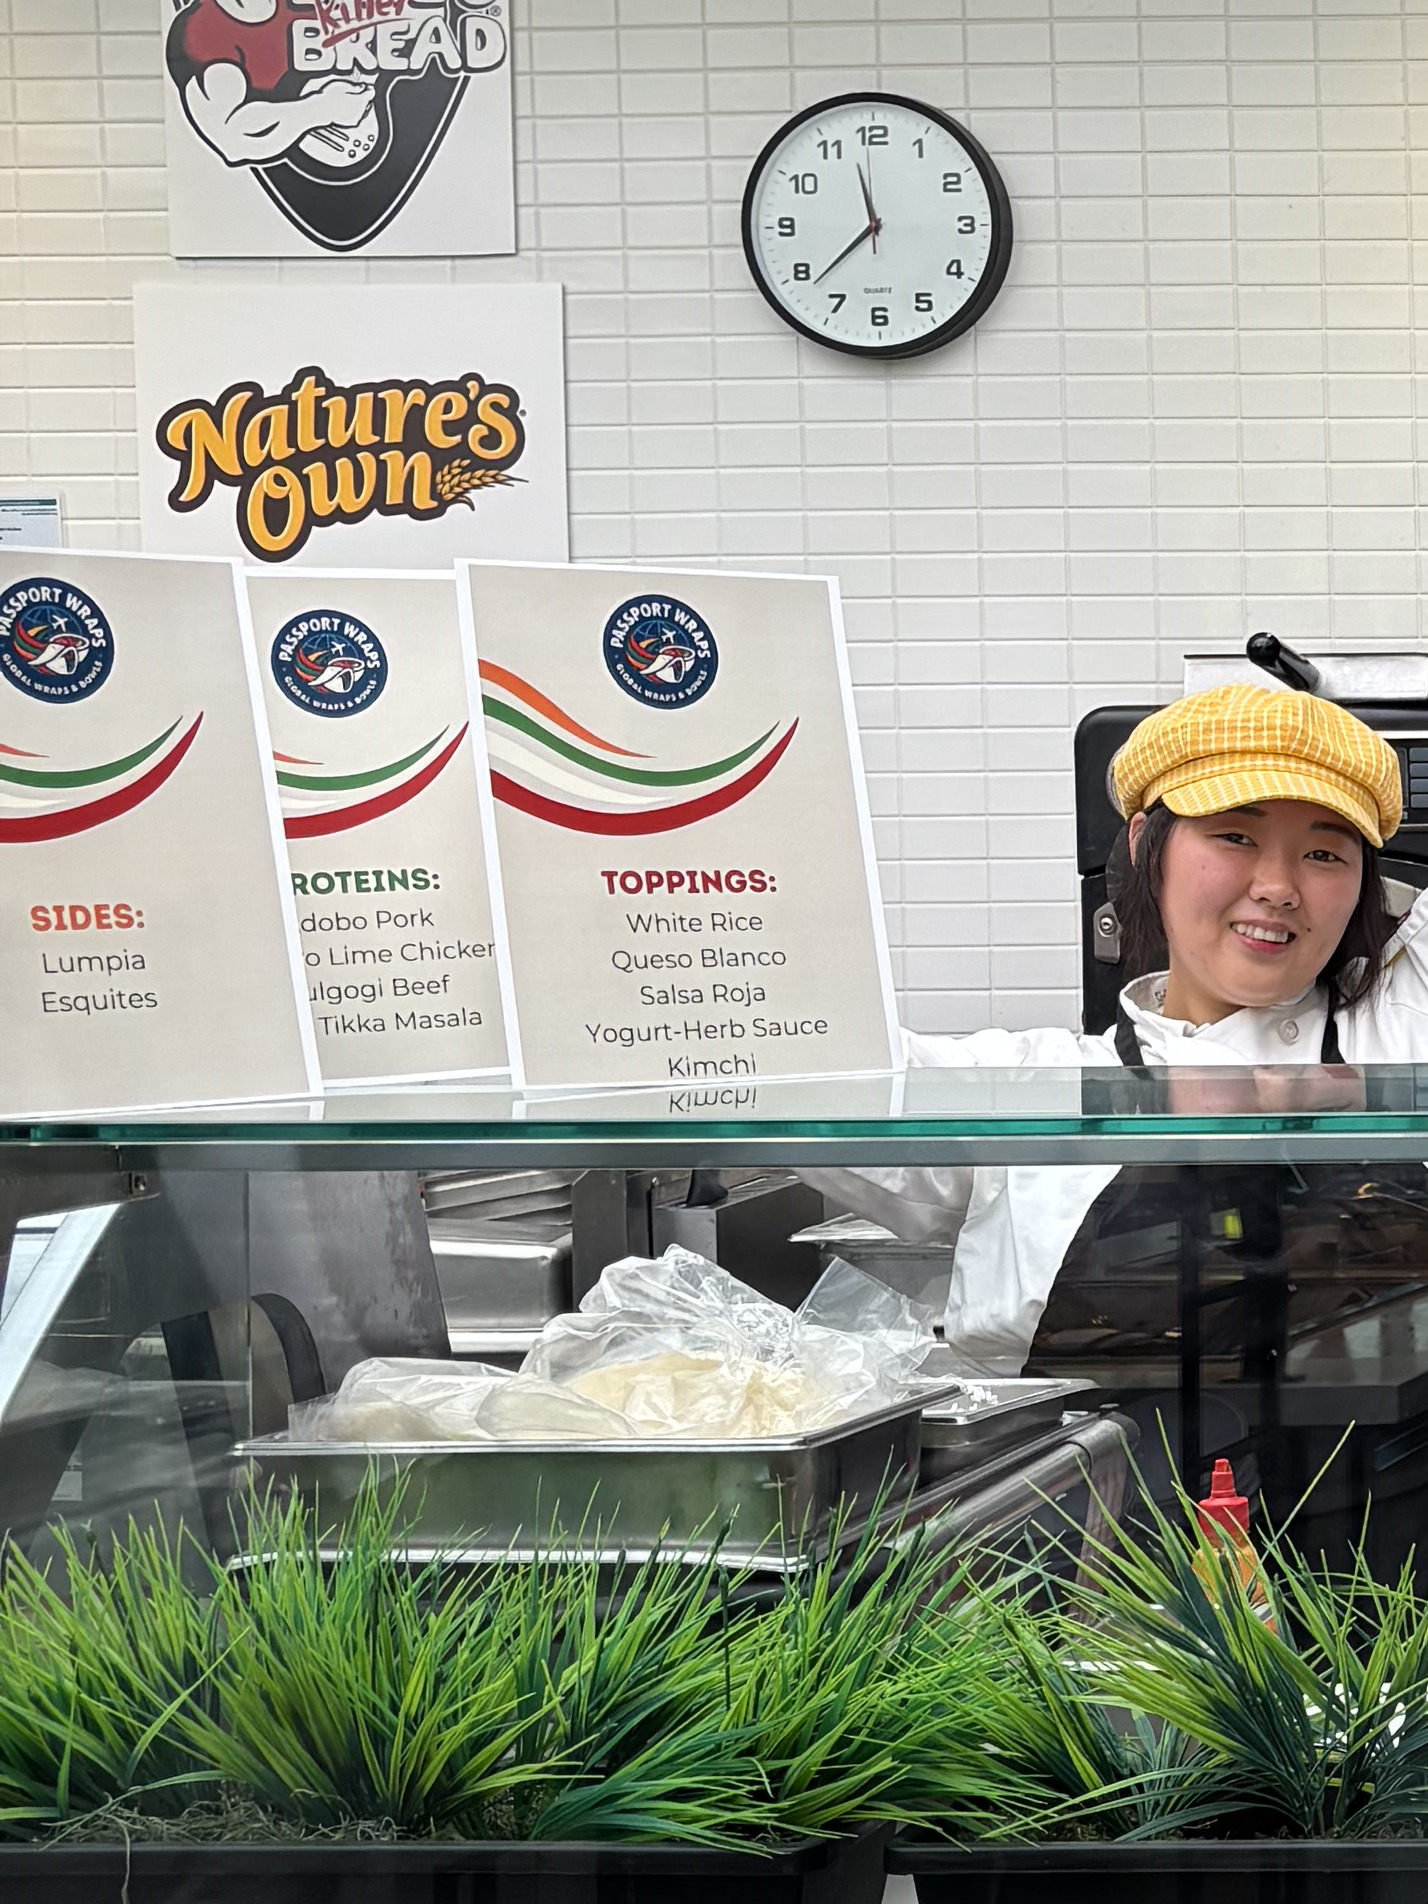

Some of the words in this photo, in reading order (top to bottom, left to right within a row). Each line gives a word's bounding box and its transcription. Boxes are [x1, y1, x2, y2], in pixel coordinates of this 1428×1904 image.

[292, 16, 506, 72] BREAD
[855, 125, 889, 146] 12
[816, 139, 842, 160] 11
[912, 138, 924, 159] 1
[788, 172, 818, 195] 10
[942, 172, 962, 193] 2
[777, 216, 796, 237] 9
[956, 215, 976, 235] 3
[792, 262, 811, 281] 8
[945, 258, 964, 279] 4
[827, 293, 847, 313] 7
[914, 292, 933, 312] 5
[870, 306, 889, 326] 6
[165, 374, 518, 503] Nature's
[246, 449, 439, 553] Own
[65, 592, 107, 649] WRAPS
[610, 602, 672, 648] PASSPORT
[674, 607, 711, 659] WRAPS
[278, 616, 341, 662] PASSPORT
[343, 621, 381, 669] WRAPS
[290, 868, 441, 896] ROTEINS:
[600, 869, 778, 895] TOPPINGS:
[30, 903, 145, 932] SIDES:
[300, 911, 368, 933] dobo
[375, 908, 435, 930] Pork
[626, 912, 703, 934] White
[710, 910, 764, 933] Rice
[42, 948, 146, 977] Lumpia
[329, 944, 393, 966] Lime
[611, 949, 693, 973] Queso
[700, 946, 787, 968] Blanco
[41, 987, 158, 1016] Esquites
[309, 977, 384, 1005] ulgogi
[392, 974, 451, 997] Beef
[640, 984, 704, 1006] Salsa
[712, 981, 766, 1007] Roja
[317, 1014, 387, 1036] Tikka
[395, 1007, 483, 1030] Masala
[585, 1017, 746, 1047] Yogurt-Herb
[752, 1017, 829, 1038] Sauce
[668, 1052, 757, 1077] Kimchi
